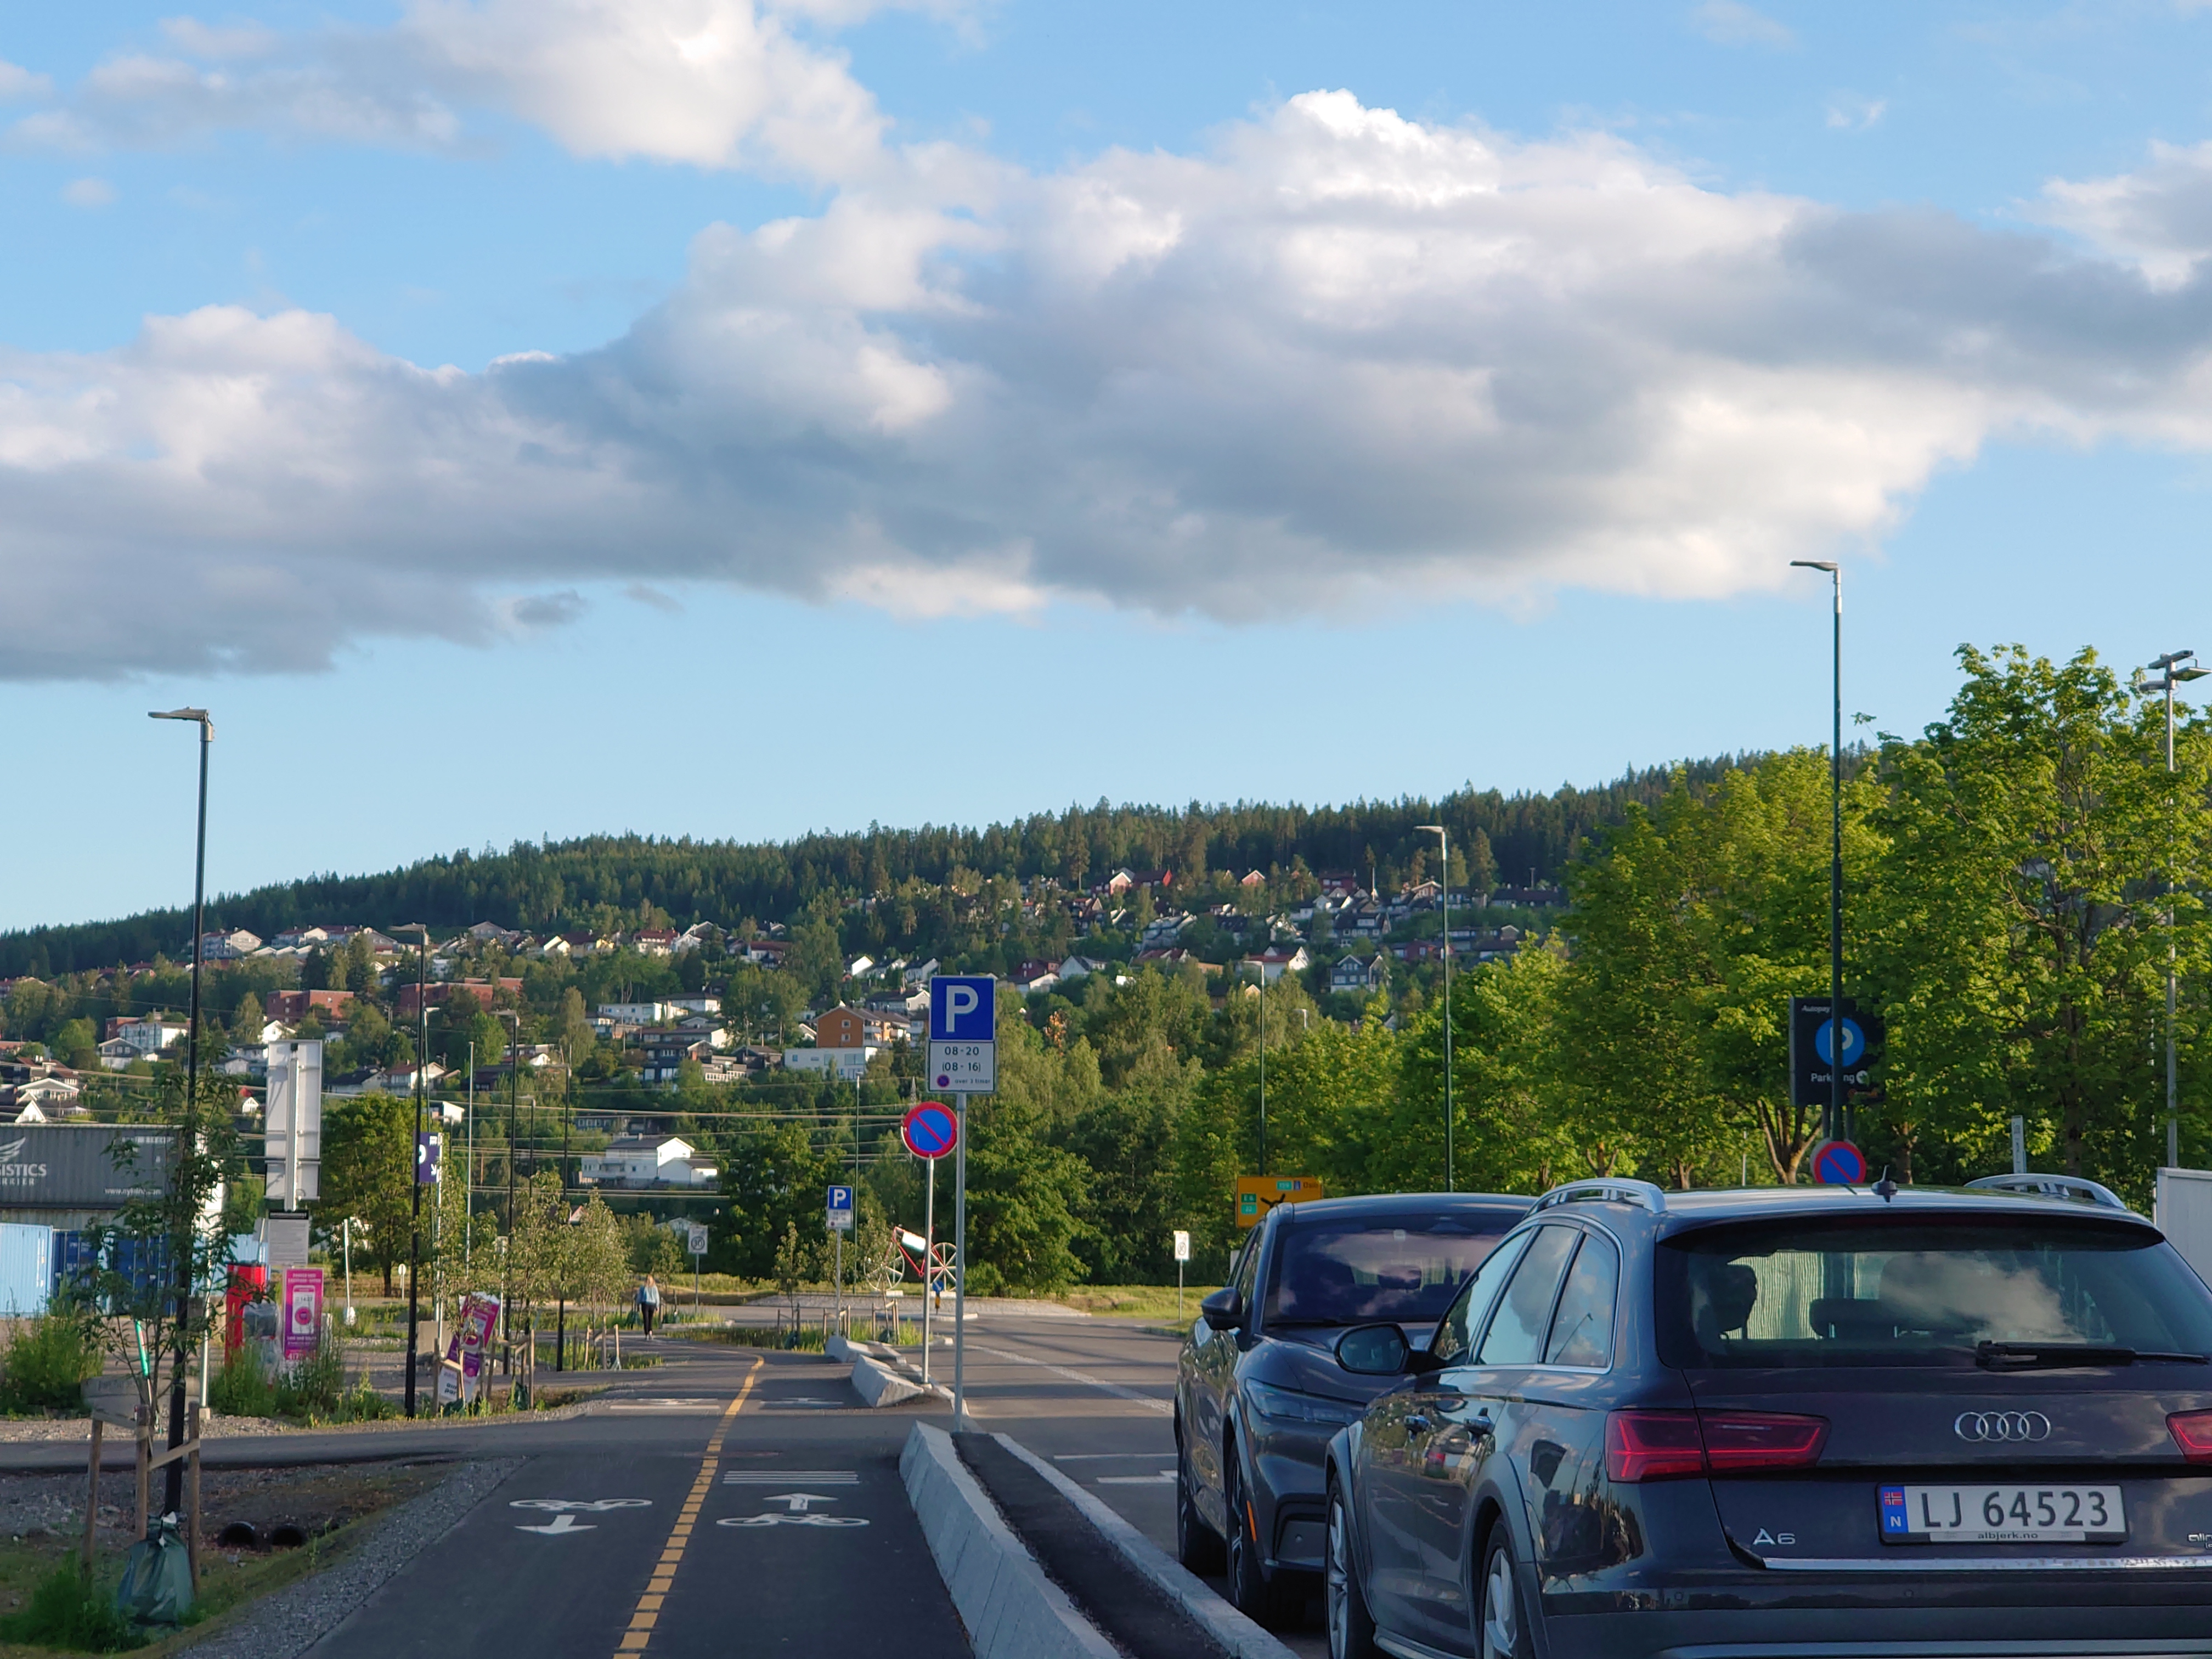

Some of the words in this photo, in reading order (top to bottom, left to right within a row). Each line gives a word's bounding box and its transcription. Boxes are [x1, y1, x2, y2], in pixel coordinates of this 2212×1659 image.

[946, 985, 978, 1032] P
[1801, 1005, 1831, 1013] Autopay
[1811, 1073, 1855, 1084] Parkng
[0, 1164, 47, 1177] ISTICS
[834, 1189, 847, 1207] P
[1921, 1492, 1962, 1527] LJ
[1983, 1491, 2108, 1527] 64523
[1891, 1516, 1901, 1527] N
[1753, 1528, 1796, 1545] A6
[1977, 1531, 2039, 1540] albjerk.no
